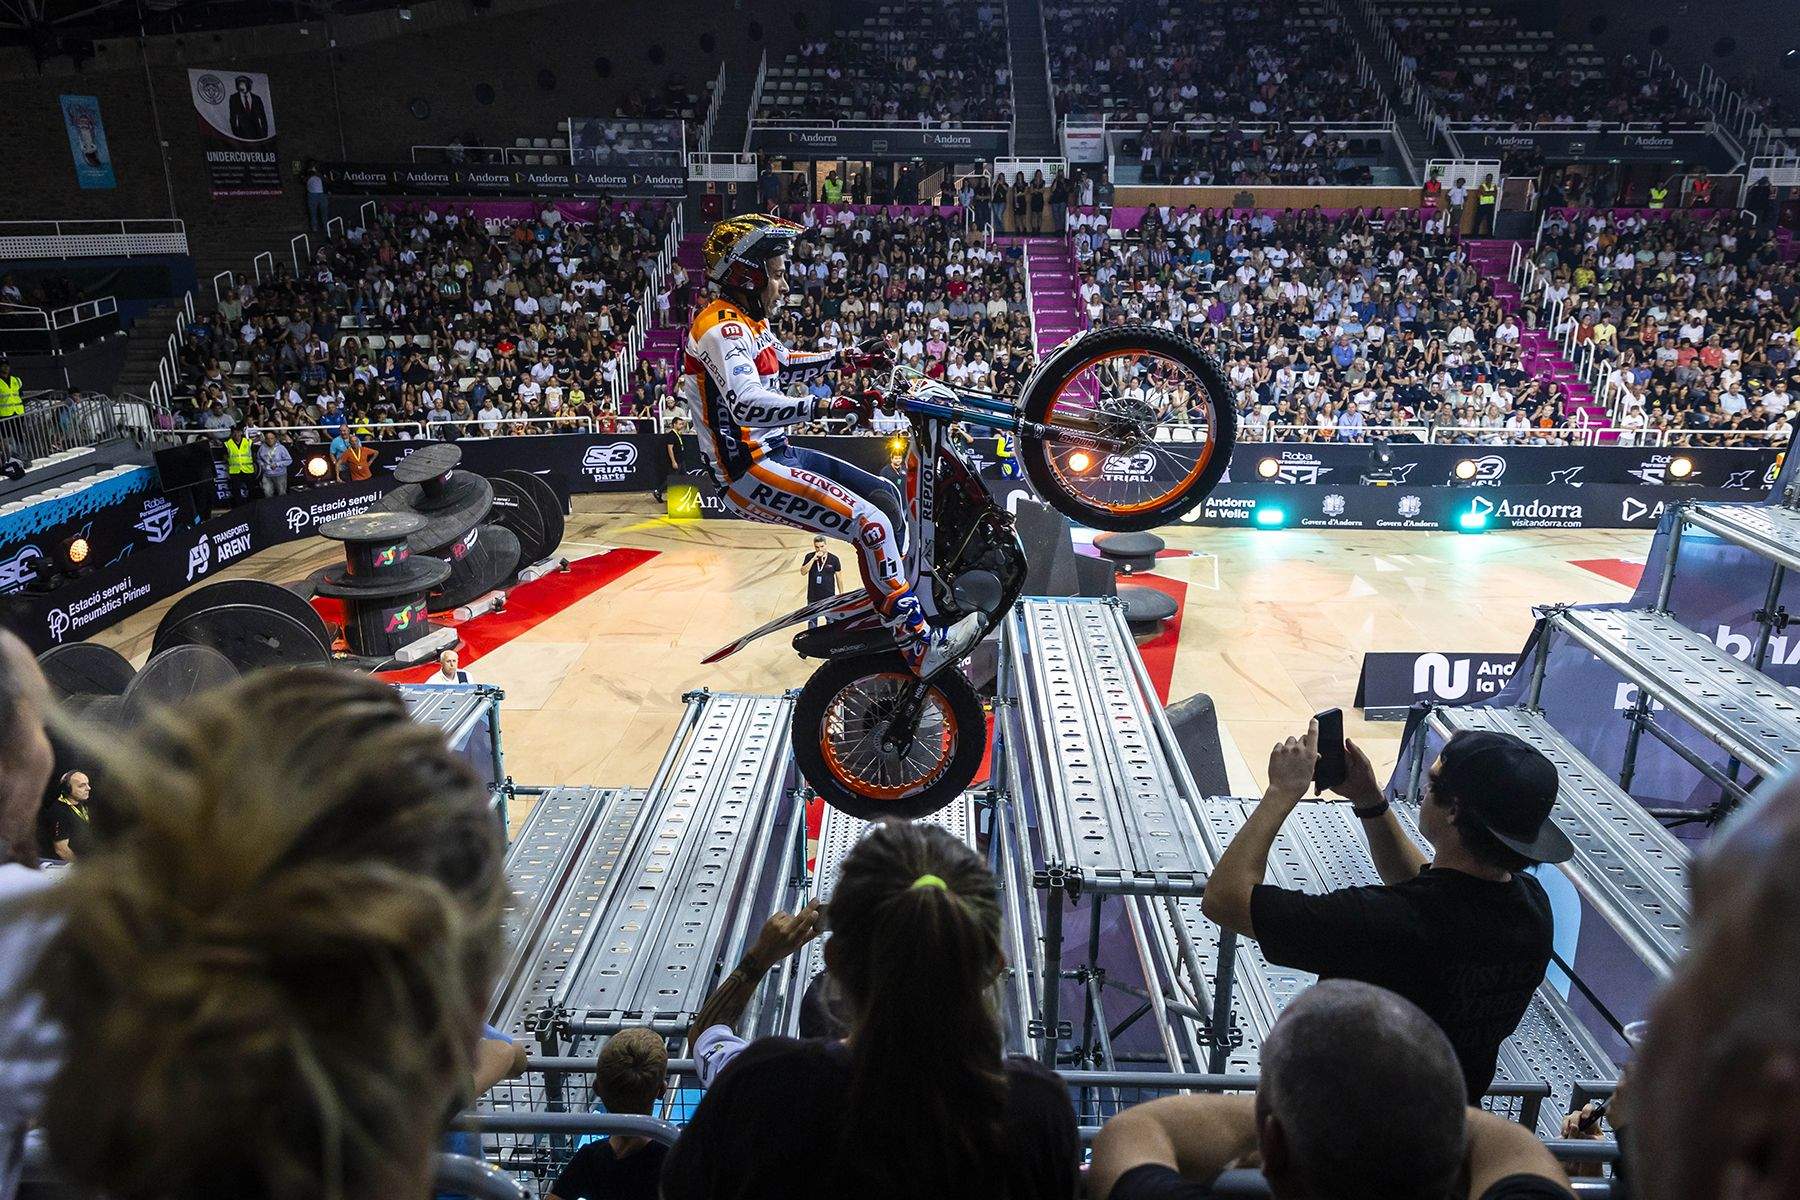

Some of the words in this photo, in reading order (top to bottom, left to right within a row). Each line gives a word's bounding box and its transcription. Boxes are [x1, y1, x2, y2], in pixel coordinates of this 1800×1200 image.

[800, 133, 837, 142] Andorra
[934, 134, 971, 144] Andorra
[206, 151, 276, 162] UNDERCOVERLAB
[343, 171, 387, 181] Andorra
[406, 171, 449, 182] Andorra
[468, 172, 509, 182] Andorra
[527, 173, 569, 183] Andorra
[587, 174, 627, 184] Andorra
[644, 175, 684, 184] Andorra
[725, 389, 808, 423] REPSOL
[1282, 451, 1313, 460] Roba
[593, 473, 626, 482] parts
[789, 467, 857, 510] HONDA
[922, 462, 934, 521] REPSOL
[143, 497, 165, 511] Roba
[310, 498, 347, 515] Estació
[348, 493, 377, 506] servei
[1205, 497, 1256, 508] Andorra
[749, 483, 852, 535] REPSOL
[1205, 508, 1217, 519] la
[1218, 508, 1250, 519] Vella
[1495, 499, 1583, 519] Andorra
[1301, 518, 1326, 526] Govern
[1327, 518, 1363, 526] d'Andorra
[1376, 519, 1402, 528] Govern
[1403, 519, 1439, 528] d'Andorra
[1511, 518, 1582, 528] visitandorra.com
[212, 523, 250, 544] TRANSPORTS
[217, 534, 251, 563] ARENY
[69, 590, 101, 616] Estació
[102, 581, 127, 599] servei
[72, 598, 122, 630] Pneumàtics
[122, 583, 151, 604] Pirineu
[1476, 678, 1495, 693] la
